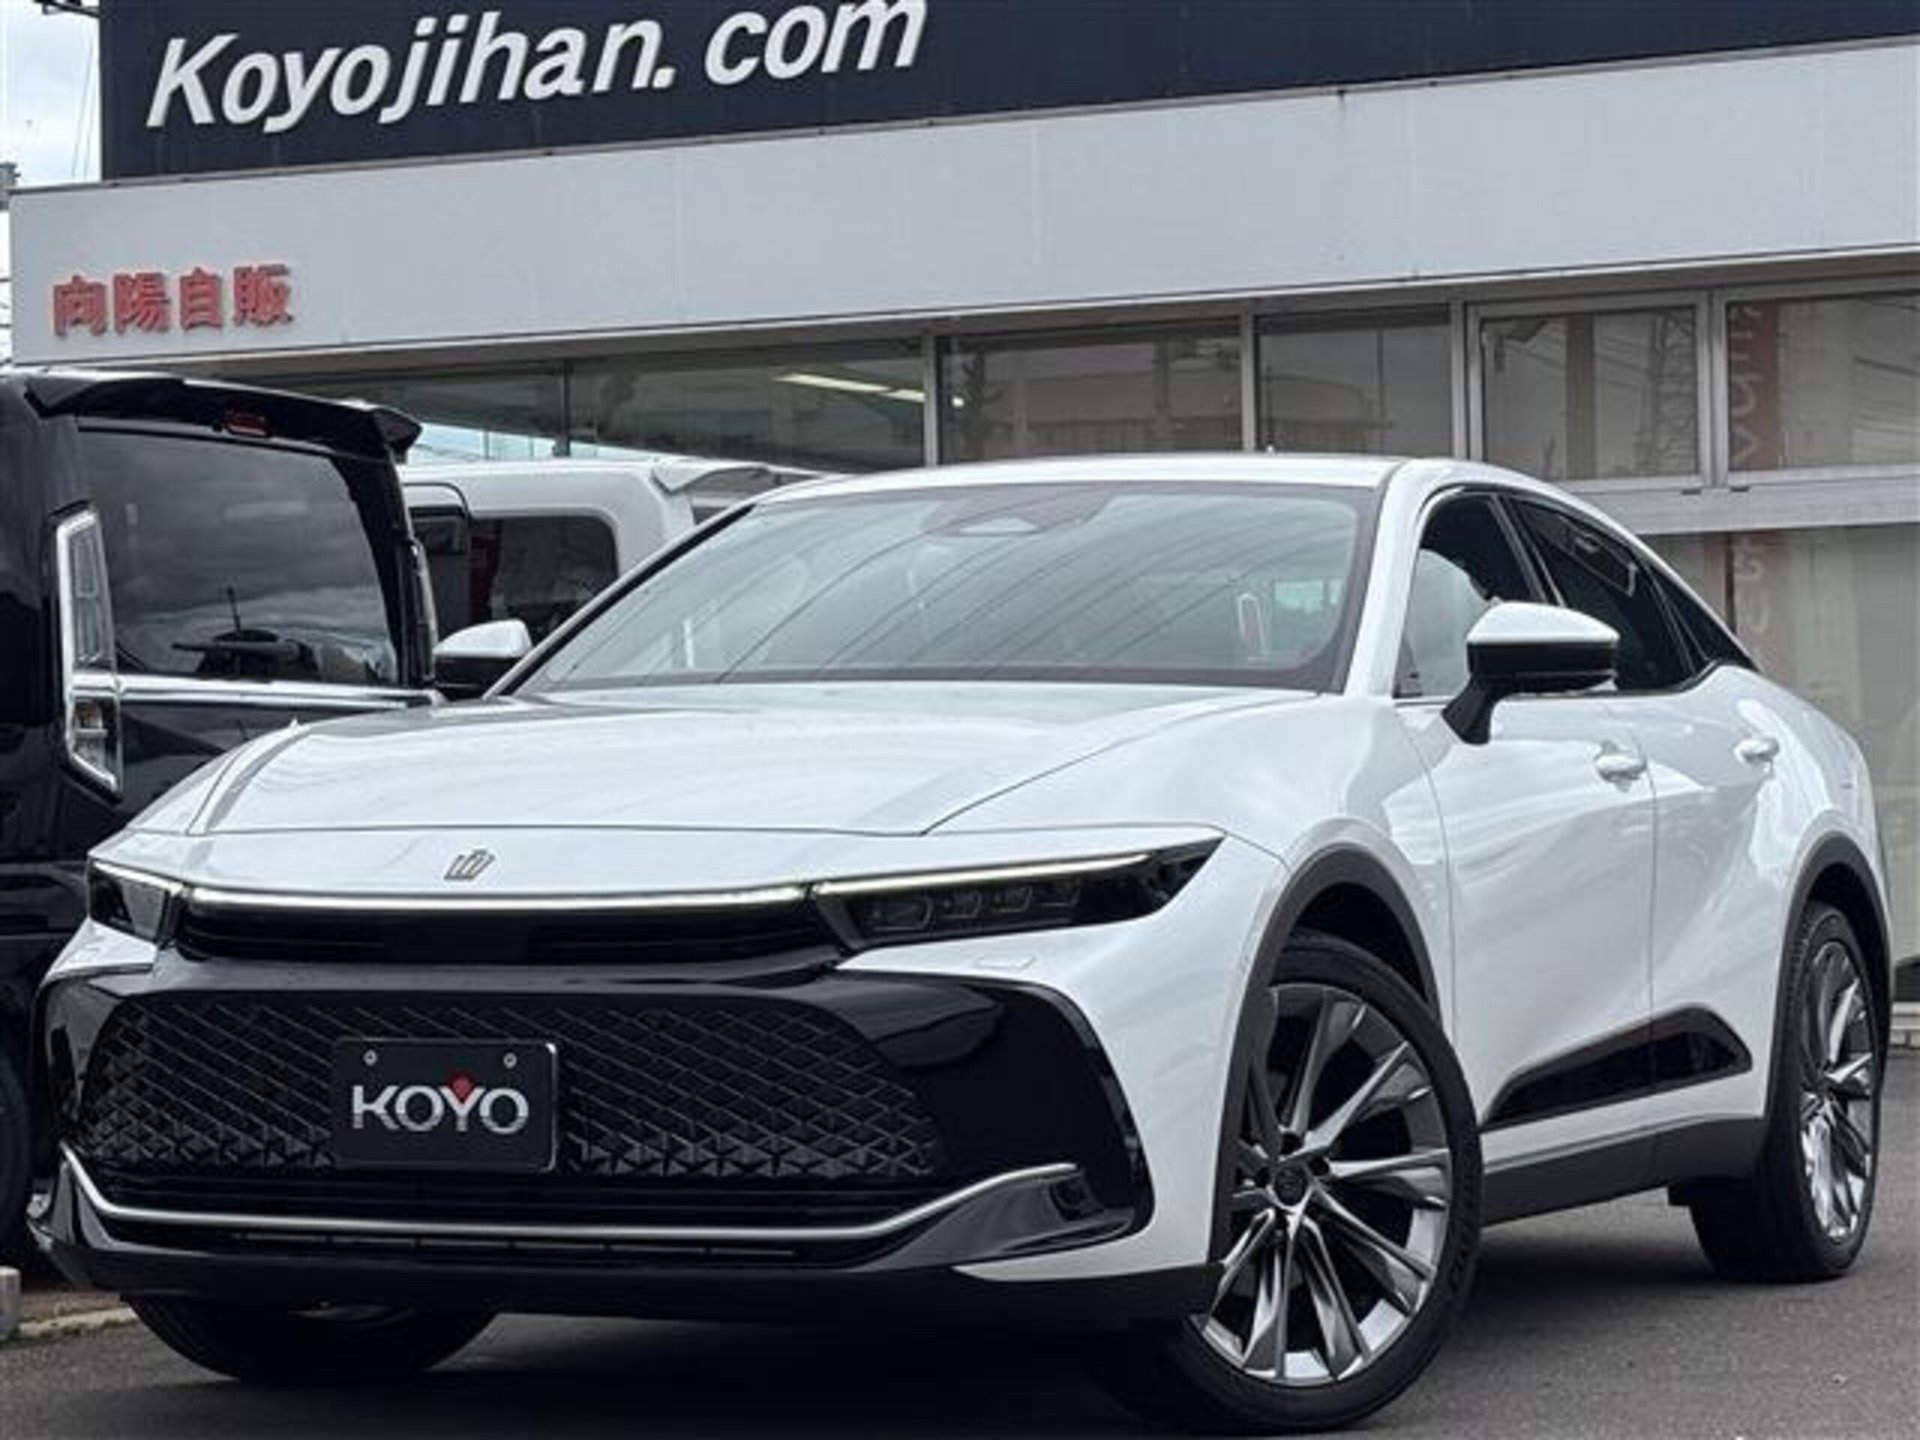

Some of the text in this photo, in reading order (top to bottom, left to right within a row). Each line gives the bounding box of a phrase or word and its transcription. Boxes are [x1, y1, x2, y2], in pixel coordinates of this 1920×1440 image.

[52, 264, 293, 337] 向陽自販
[352, 1084, 529, 1134] KOYO
